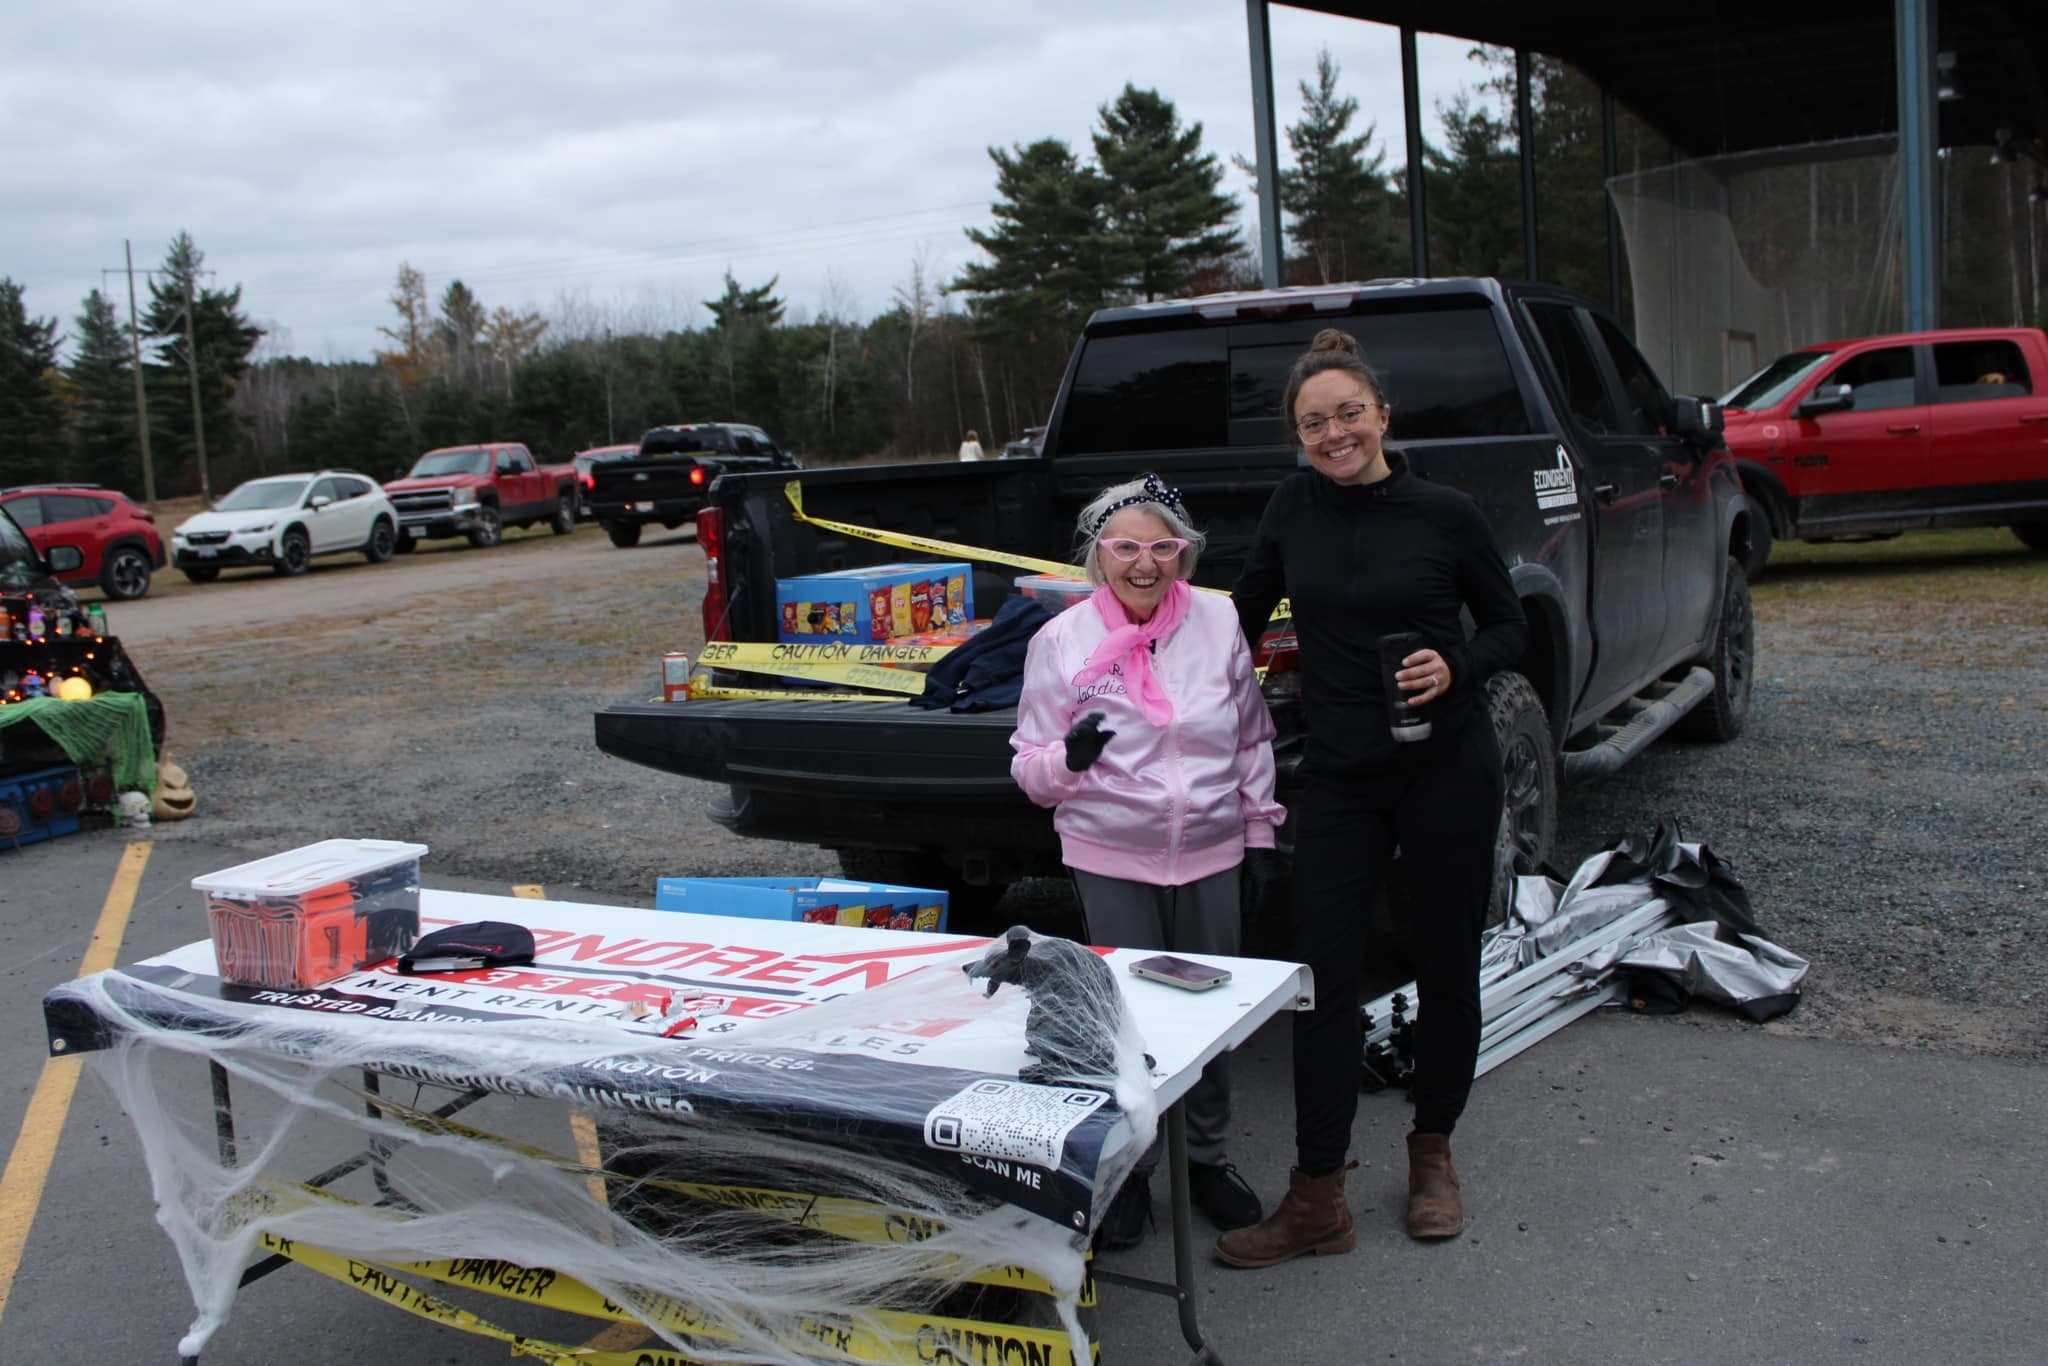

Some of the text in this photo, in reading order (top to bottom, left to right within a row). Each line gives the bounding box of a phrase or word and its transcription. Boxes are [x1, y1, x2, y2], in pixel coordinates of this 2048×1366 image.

[771, 644, 850, 661] CAUTION
[859, 645, 932, 662] DANGER
[1077, 679, 1128, 705] Ladie
[249, 990, 369, 1013] TRUSTED
[484, 992, 656, 1024] RENTAL
[959, 1152, 1042, 1191] SCAN ME
[448, 1256, 557, 1299] DANGER
[916, 1323, 1053, 1366] CAUTION
